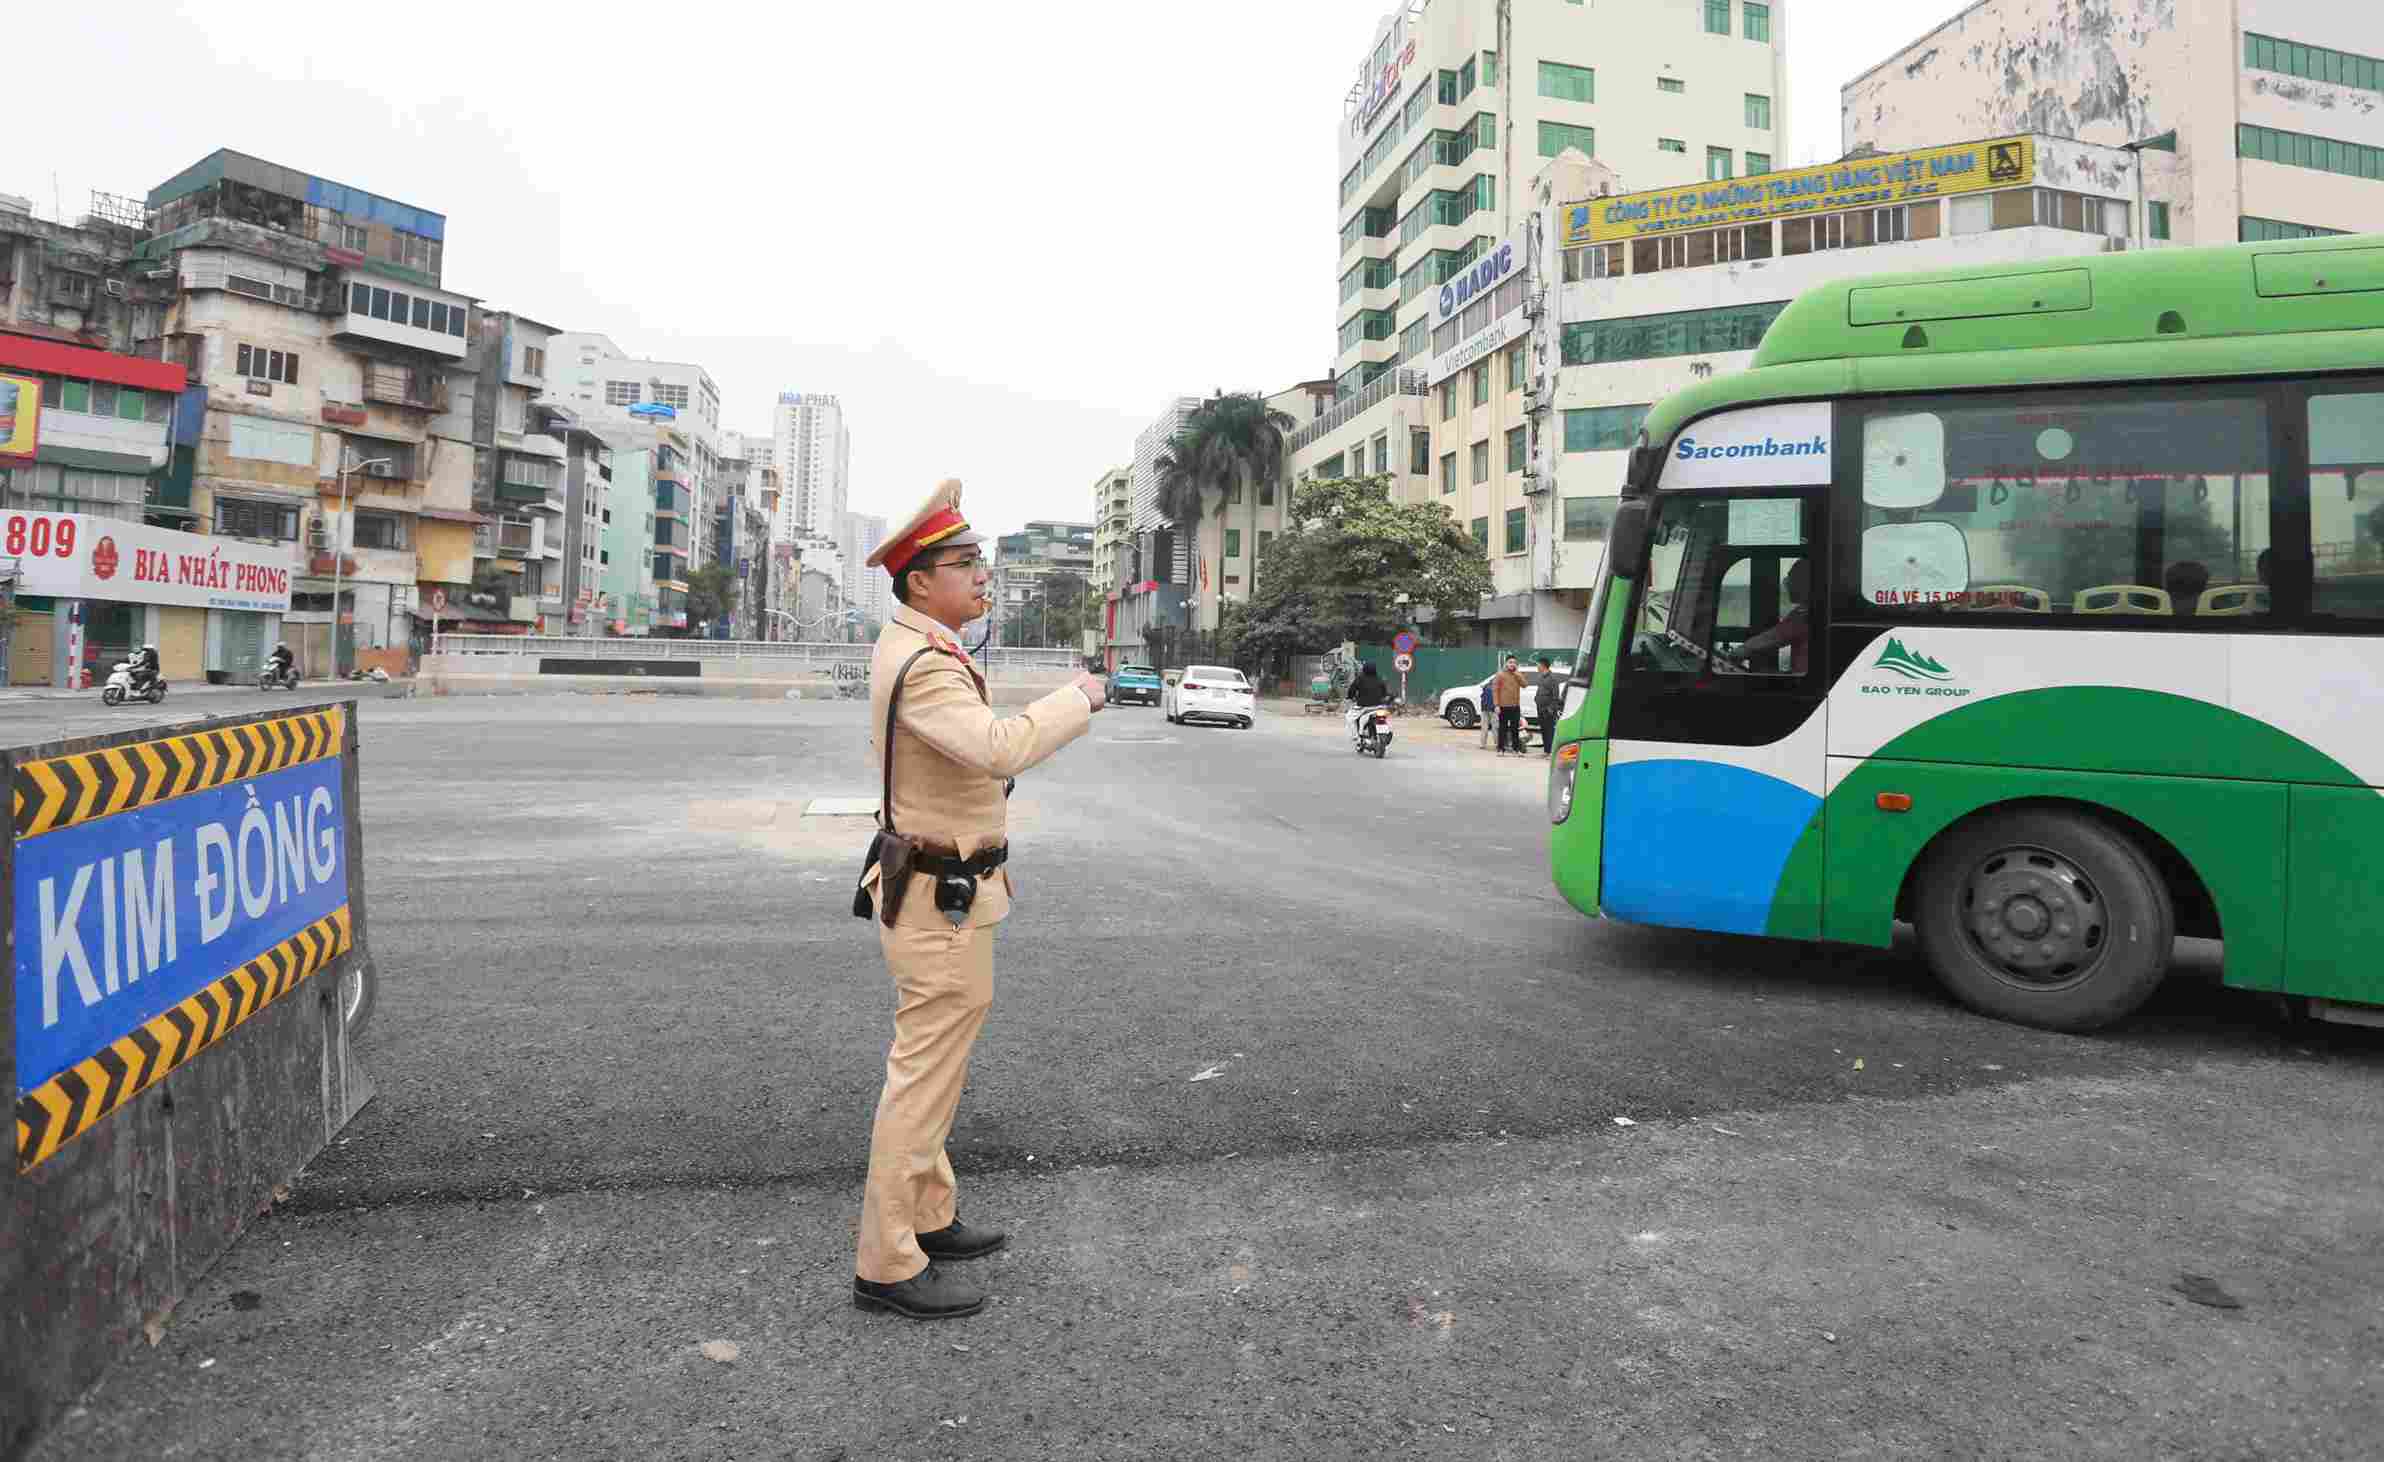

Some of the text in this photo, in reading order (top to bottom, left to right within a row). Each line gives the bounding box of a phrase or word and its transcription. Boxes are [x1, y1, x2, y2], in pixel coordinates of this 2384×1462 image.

[1655, 194, 1675, 216] TY
[1768, 175, 1825, 199] TRANG
[1930, 151, 1977, 177] NAM
[1676, 435, 1827, 460] Sacombank
[6, 515, 77, 558] 809
[134, 545, 288, 594] BIA NHẤT PHONG
[1895, 686, 1921, 696] YEN
[1925, 687, 1972, 697] GROUP
[38, 783, 337, 1029] KIM ĐỒNG
